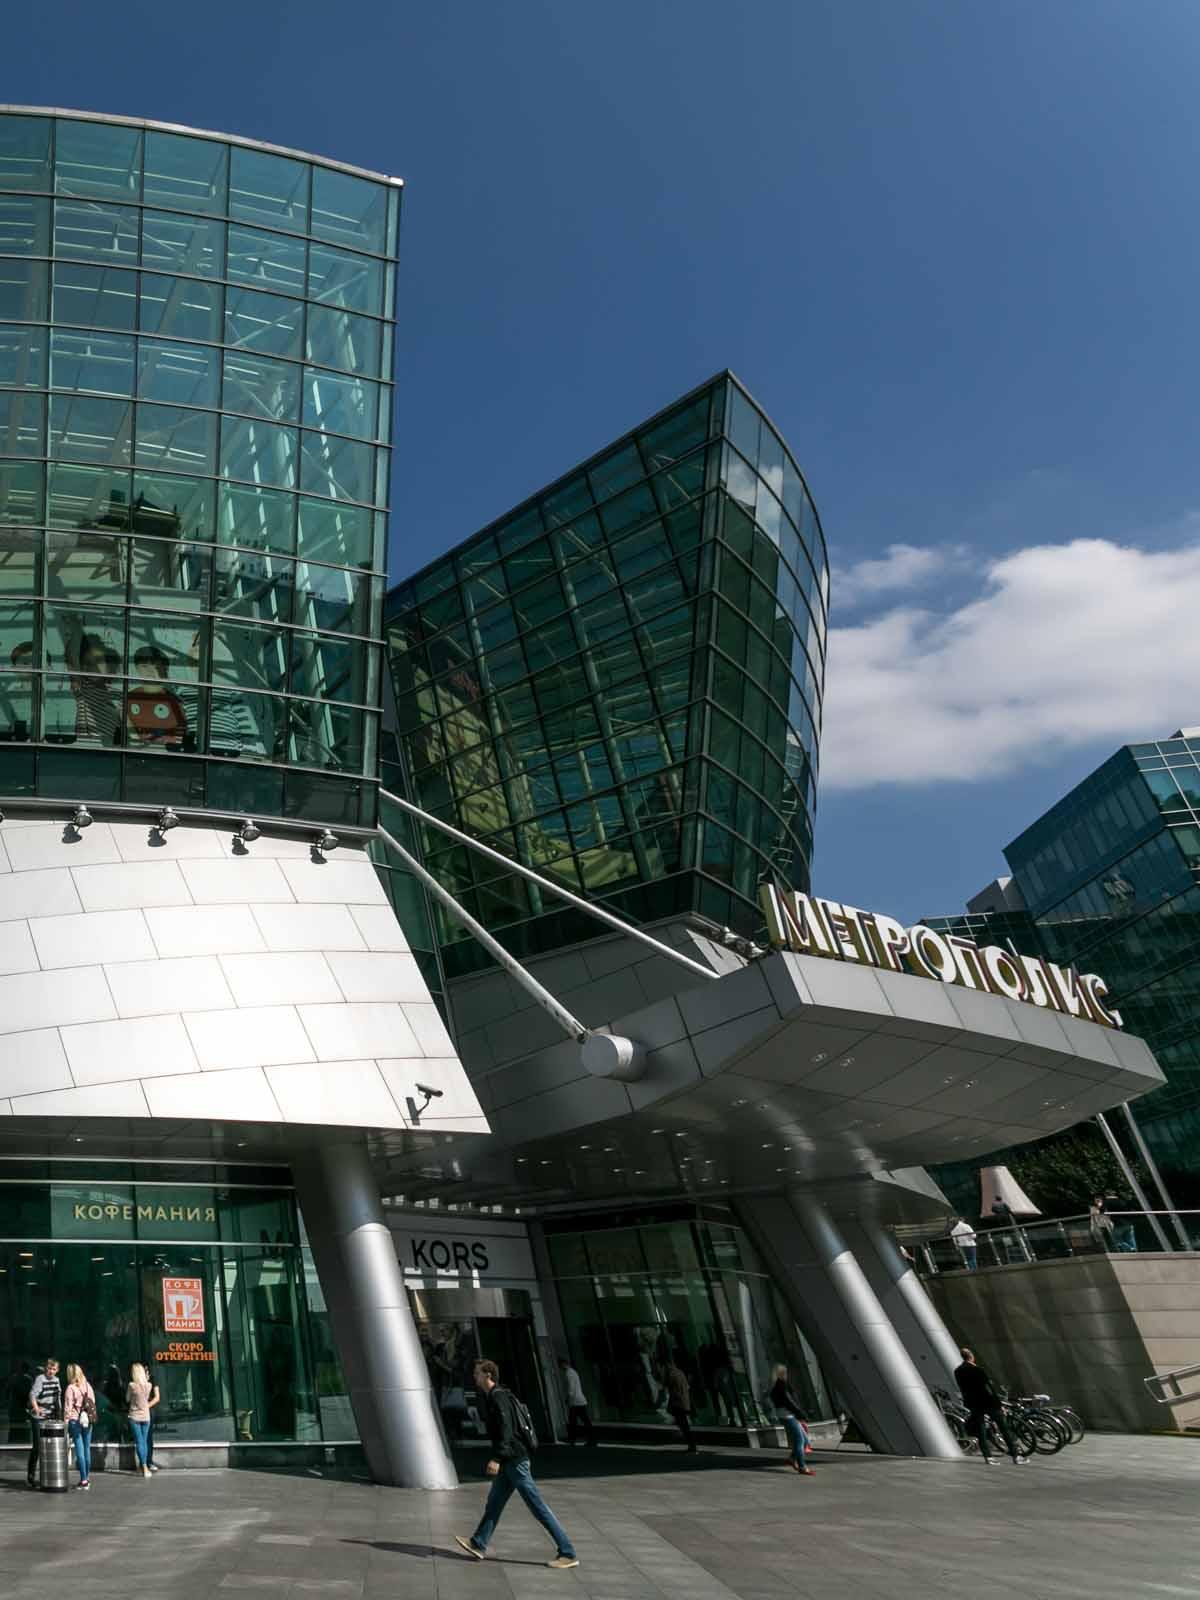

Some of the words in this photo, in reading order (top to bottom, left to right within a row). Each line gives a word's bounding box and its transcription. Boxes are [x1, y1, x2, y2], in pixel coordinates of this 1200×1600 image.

[762, 881, 1125, 1030] МЕТРОПОЛИС
[75, 1204, 216, 1223] КОФЕМАНИЯ
[410, 1239, 489, 1271] KORS
[167, 1320, 202, 1328] МАНИЯ
[168, 1343, 204, 1352] СКОРО
